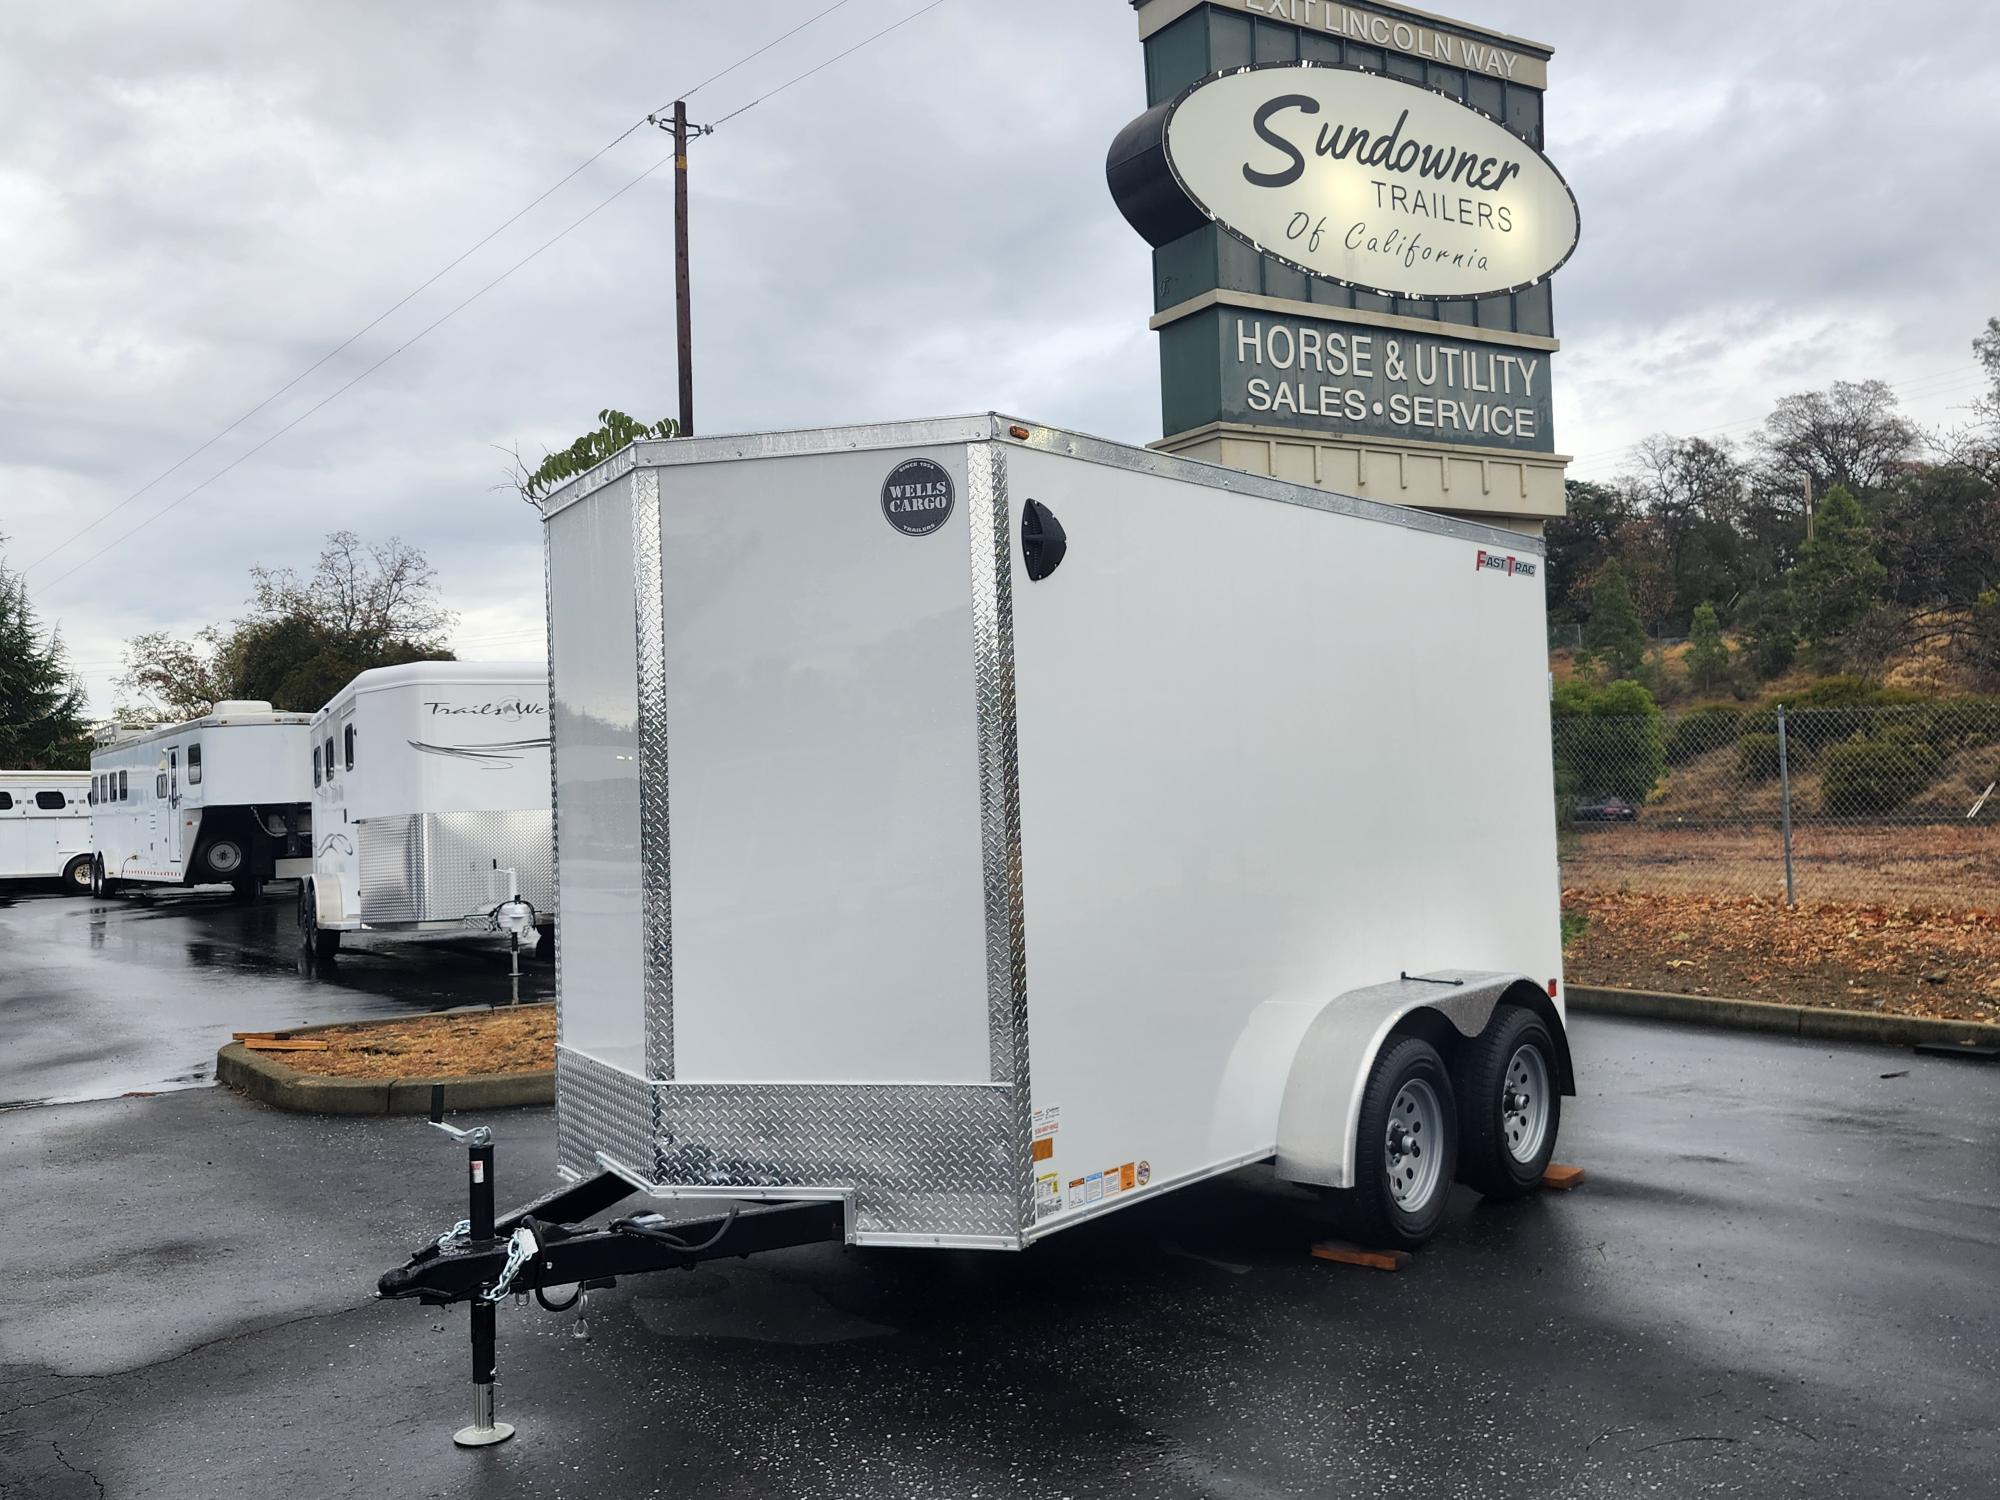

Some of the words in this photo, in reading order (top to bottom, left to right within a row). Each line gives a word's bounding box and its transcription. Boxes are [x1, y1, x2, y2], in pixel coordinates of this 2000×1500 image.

[1325, 3, 1451, 61] LINCOLN
[1460, 40, 1518, 78] WAY
[1242, 94, 1520, 191] Sundowner
[1370, 180, 1513, 233] TRAILERS
[1286, 212, 1327, 253] Of
[1344, 222, 1488, 271] California
[1236, 319, 1374, 377] HORSE
[1384, 340, 1408, 381] &
[1415, 344, 1538, 396] UTILITY
[888, 481, 947, 498] WELLS
[889, 496, 947, 513] CARGO
[423, 702, 502, 716] Trails
